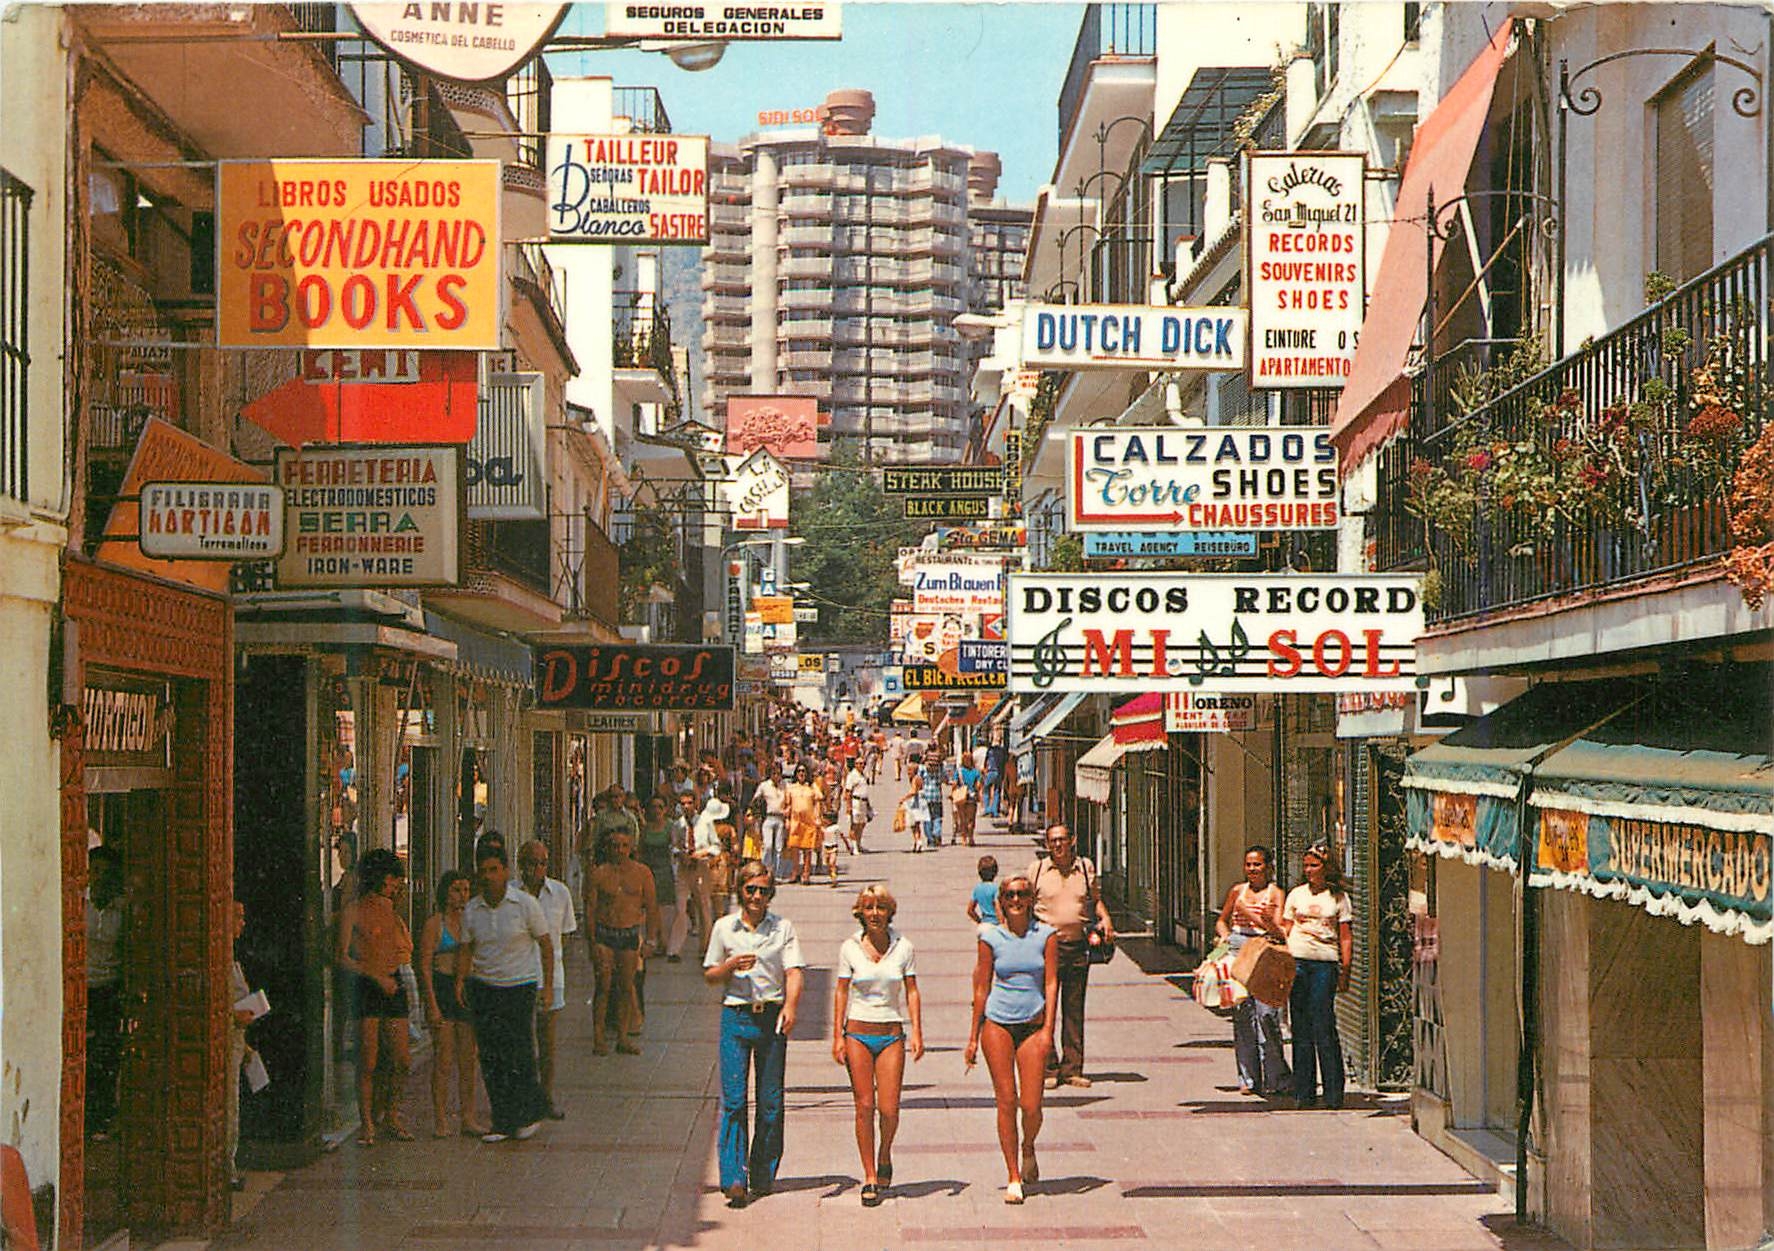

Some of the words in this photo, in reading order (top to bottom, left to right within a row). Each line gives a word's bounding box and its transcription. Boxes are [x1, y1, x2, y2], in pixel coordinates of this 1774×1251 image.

[403, 2, 504, 26] ANNE
[626, 6, 705, 20] SEGUROS
[723, 7, 824, 20] GENERALES
[664, 21, 785, 34] DELEGACION
[390, 30, 448, 46] COSMETICA
[451, 34, 469, 48] DEL
[472, 36, 516, 51] CABELLO
[584, 139, 678, 166] TAILLEUR
[590, 165, 633, 184] SEÑORAS
[638, 168, 705, 196] TAILOR
[1267, 162, 1344, 198] Galerias
[258, 180, 347, 208] LIBROS
[369, 180, 461, 208] USADOS
[550, 143, 646, 236] Blanco
[590, 197, 651, 215] CABALLEROS
[1262, 200, 1292, 223] San
[1297, 200, 1342, 233] Miguel
[1344, 203, 1357, 223] 21
[649, 213, 705, 239] SASTRE
[235, 218, 486, 270] SECONDHAND
[1269, 233, 1354, 254] RECORDS
[1260, 261, 1357, 283] SOUVENIRS
[249, 273, 469, 334] BOOKS
[1277, 289, 1349, 311] SHOES
[1036, 312, 1142, 354] DUTCH
[1161, 316, 1233, 356] DICK
[1093, 434, 1337, 463] CALZADOS
[285, 458, 438, 485] FERRETERIA
[887, 471, 942, 490] STEAK
[1085, 466, 1201, 506] Torre
[1213, 468, 1337, 498] SHOES
[286, 487, 437, 508] ELECTRODOMESTICOS
[907, 500, 944, 516] BLACK
[949, 500, 987, 516] ANGUS
[299, 511, 420, 534] SERRA
[1187, 501, 1338, 528] CHAUSSURES
[296, 536, 425, 554] FERRONNERIE
[945, 530, 973, 546] Sta
[978, 529, 1019, 546] GEMA
[1096, 541, 1134, 553] TRAVEL
[1140, 541, 1178, 553] AGENCY
[1194, 538, 1250, 553] REISEBÜRO
[308, 557, 414, 575] IRON-WARE
[915, 572, 947, 591] Zum
[948, 571, 995, 591] Blauen
[1022, 586, 1189, 614] DISCOS
[1233, 586, 1415, 614] RECORD
[1080, 628, 1171, 678] MI
[1266, 628, 1400, 678] SOL
[974, 659, 993, 670] DRY
[904, 668, 921, 687] EL
[590, 679, 730, 699] minidrug
[1175, 711, 1203, 720] RENT
[1210, 711, 1217, 720] A
[1608, 817, 1770, 901] SUPERMERCADO
